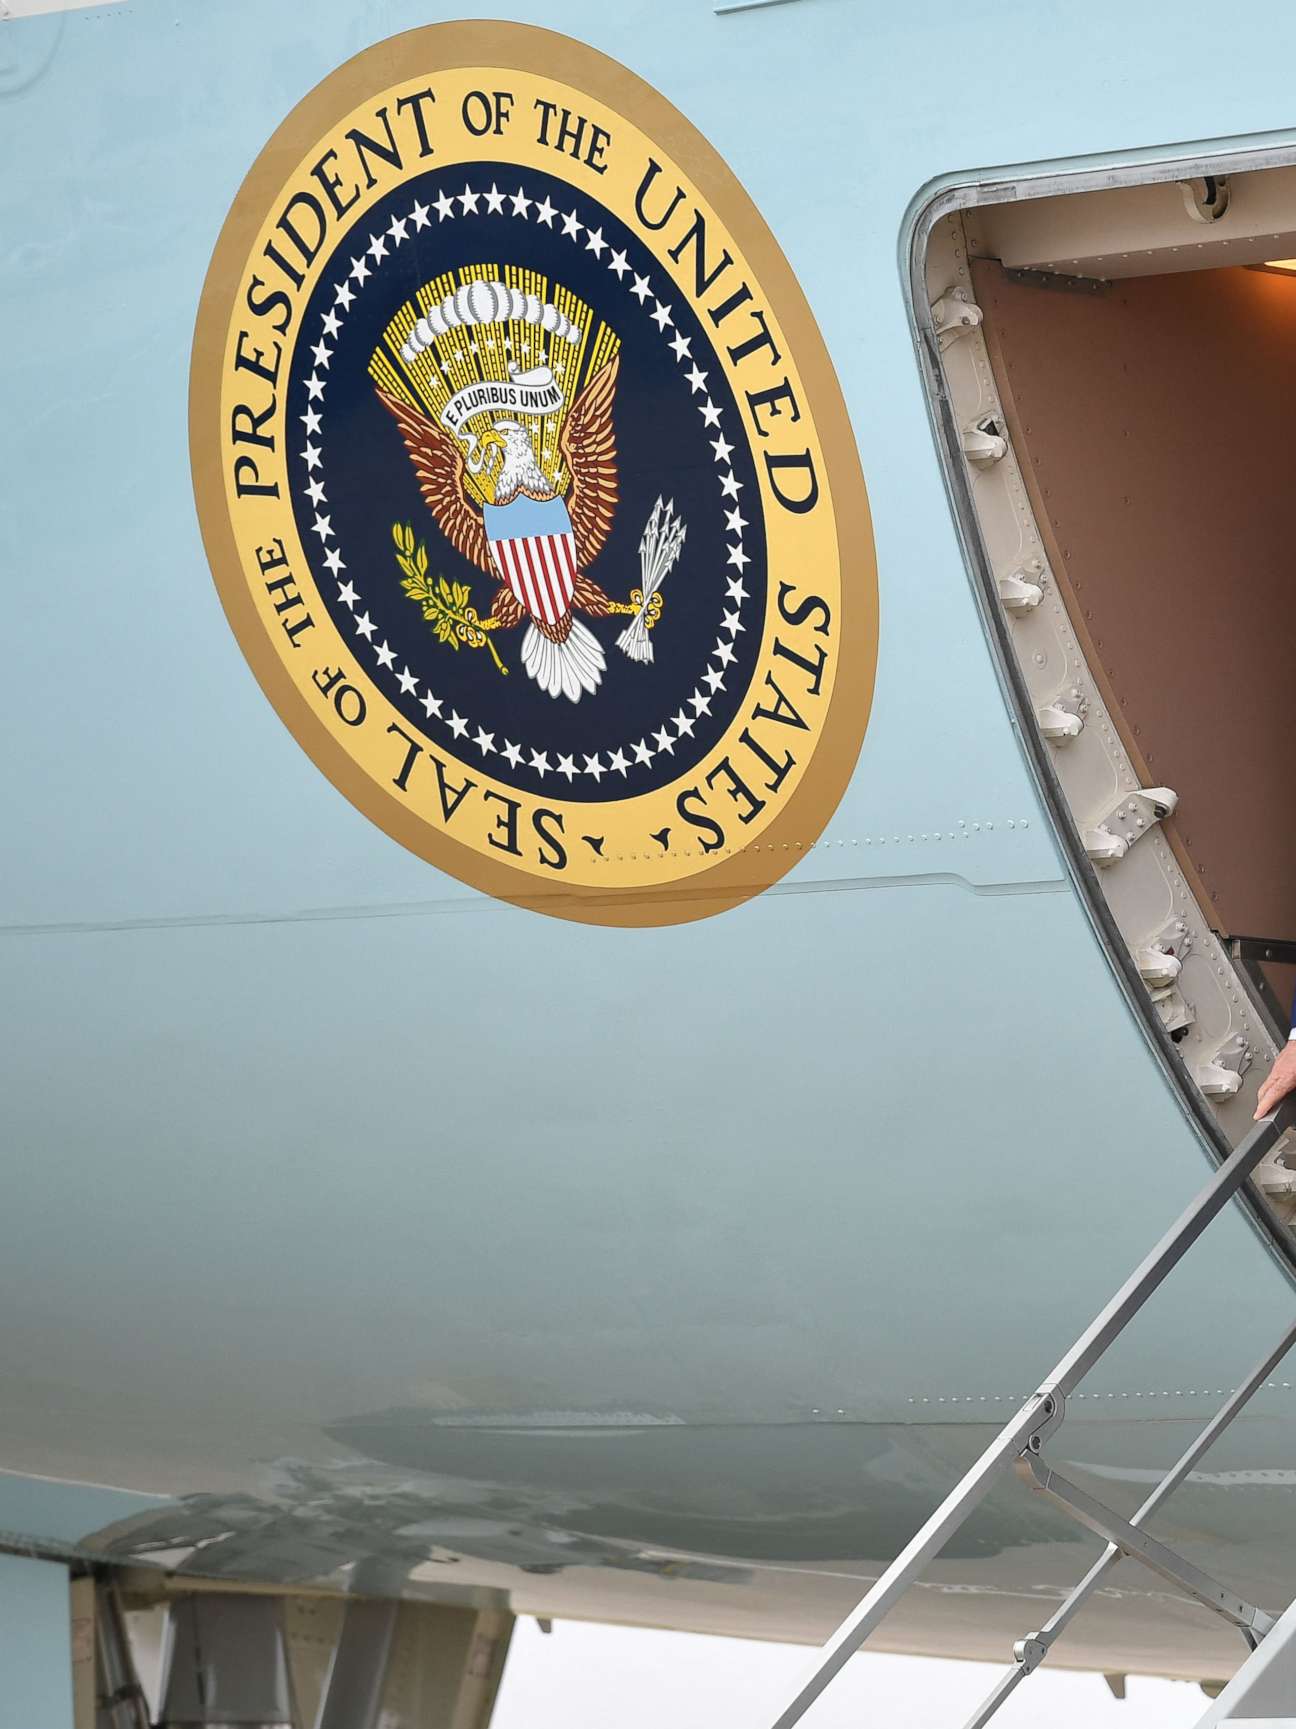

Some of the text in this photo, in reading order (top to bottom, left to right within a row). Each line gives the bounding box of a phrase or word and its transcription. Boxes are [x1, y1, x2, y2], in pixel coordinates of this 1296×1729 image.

[231, 87, 832, 870] SEAL OF THE PRESIDENT OF THE UNITED STATES
[445, 385, 561, 426] E PLURIBUS UNUM
